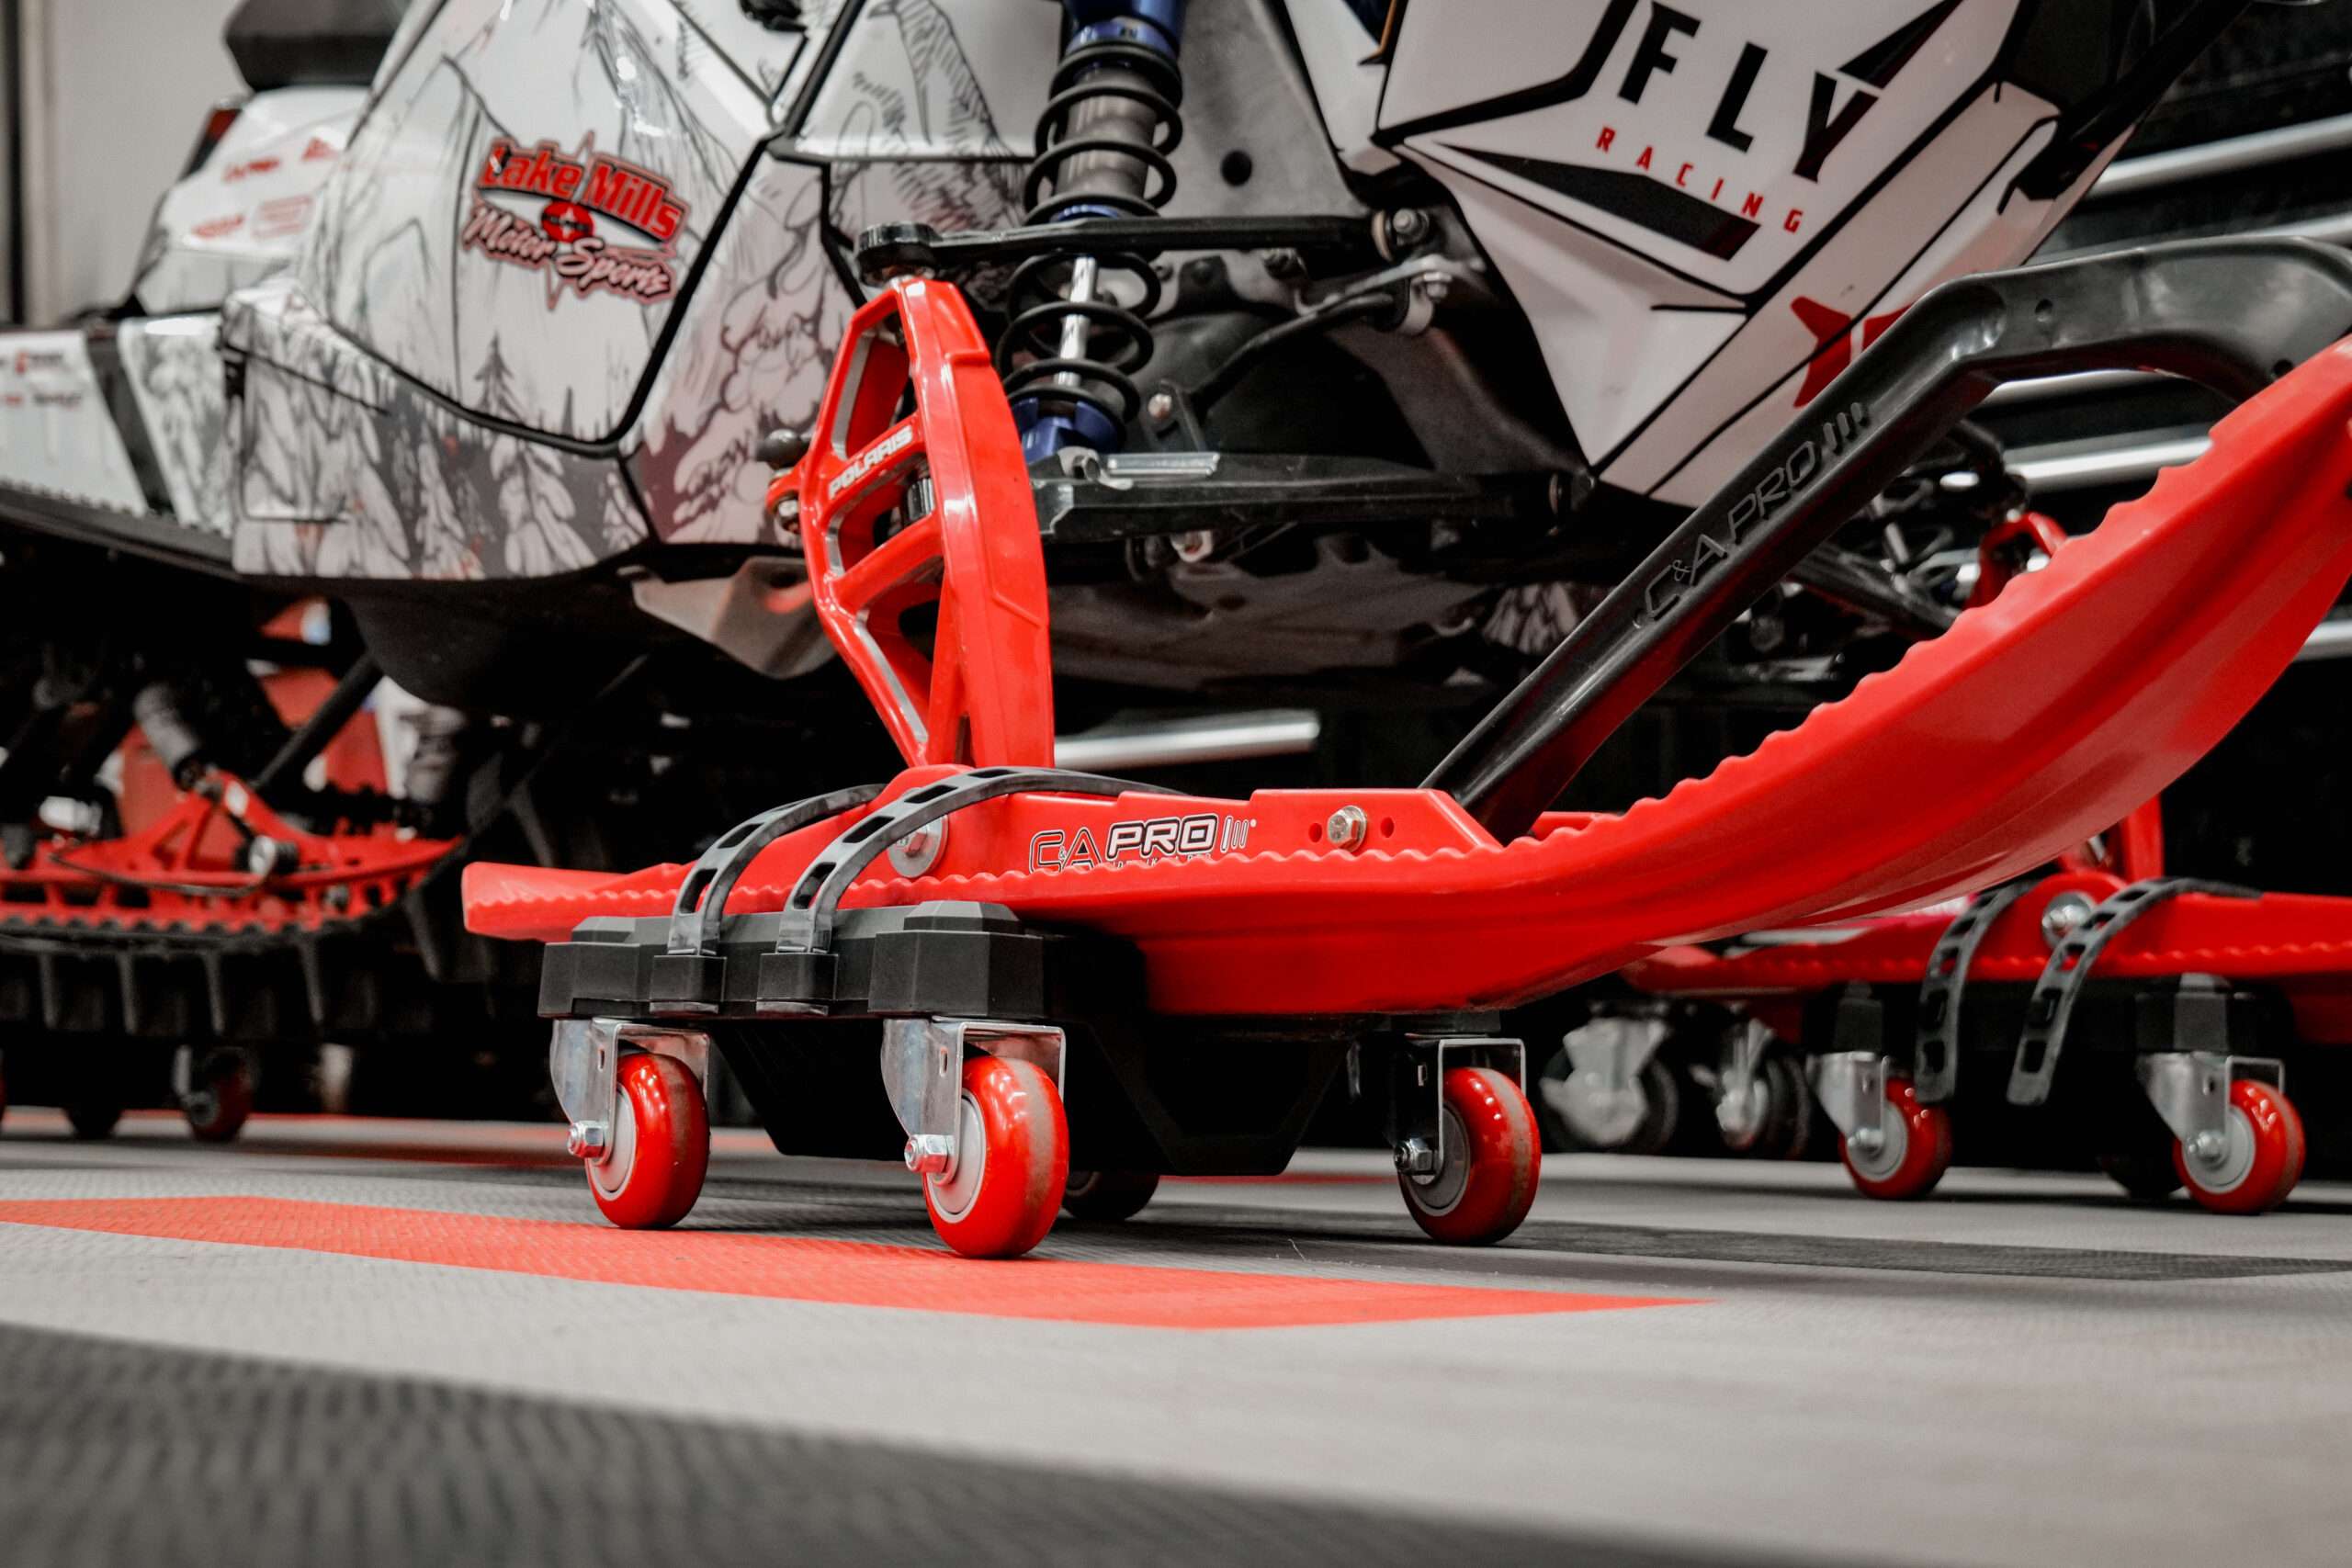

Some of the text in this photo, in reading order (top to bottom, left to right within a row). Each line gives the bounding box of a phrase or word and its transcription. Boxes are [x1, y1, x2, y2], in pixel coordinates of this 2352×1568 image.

[1618, 1, 1880, 183] FLY
[482, 145, 683, 239] Lake Mills
[1596, 126, 1803, 233] RACING
[828, 424, 913, 501] POLARIS
[1727, 440, 1816, 545] PRO
[1106, 813, 1219, 861] PRO
